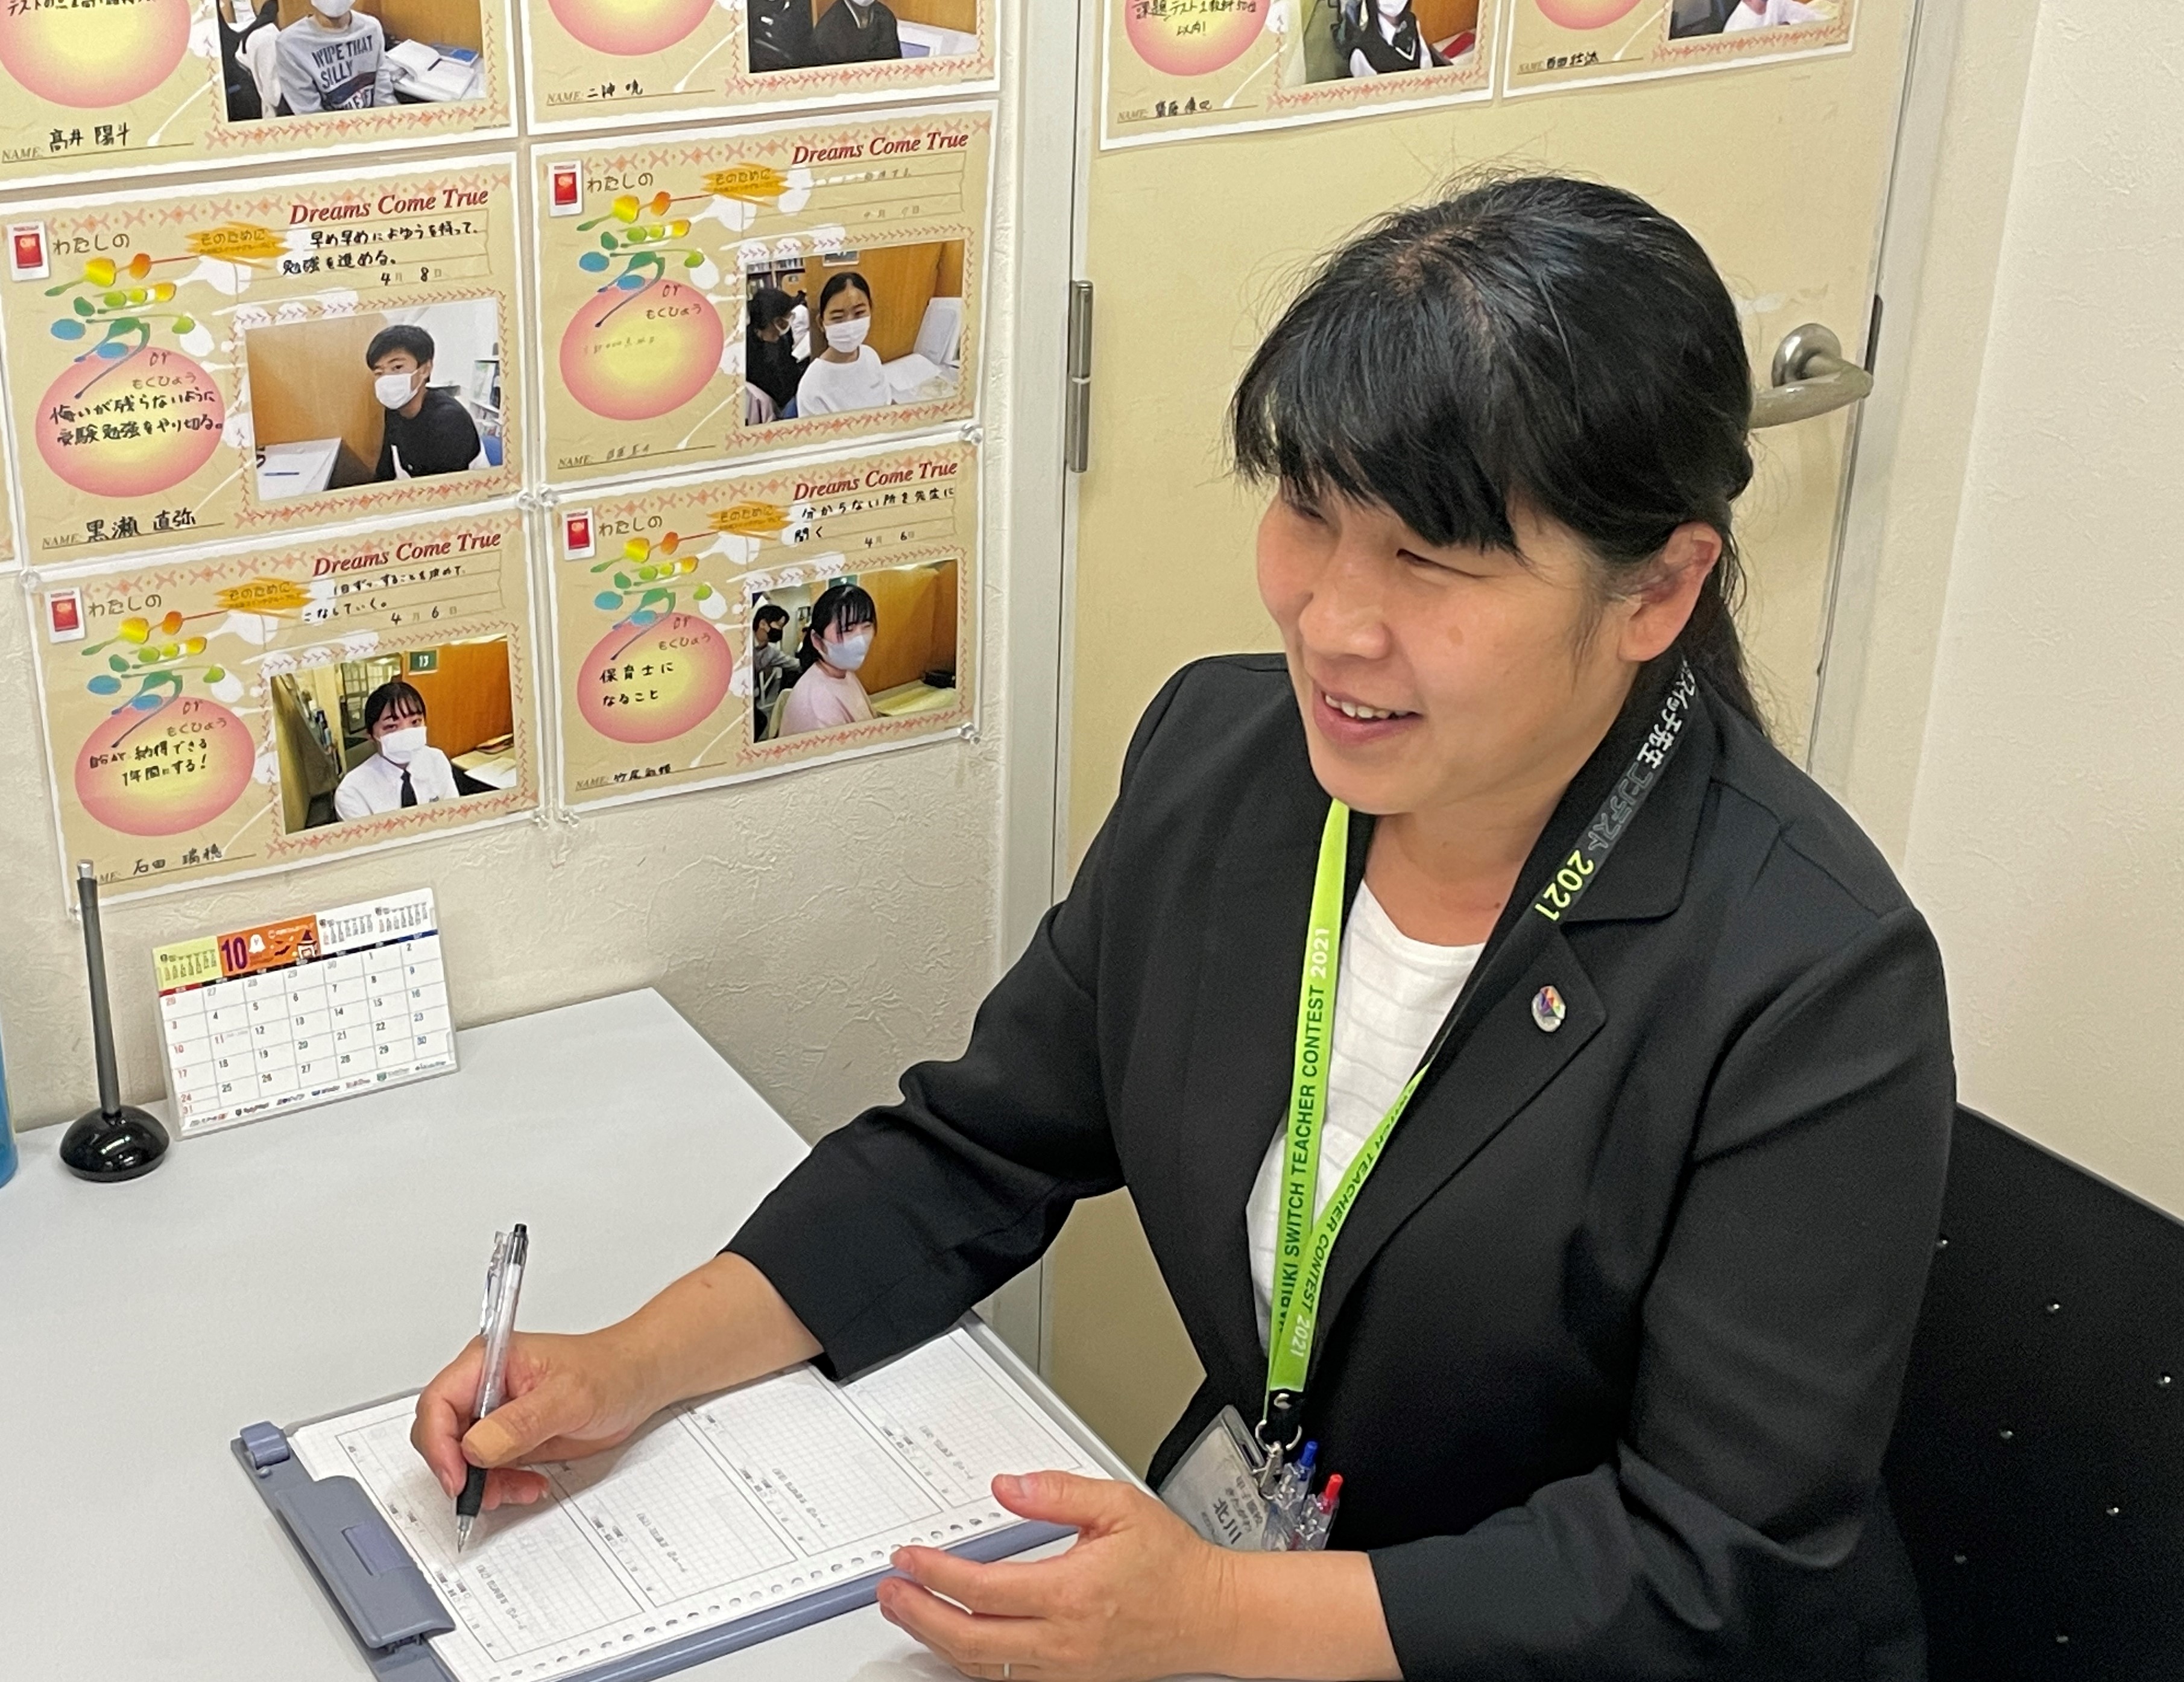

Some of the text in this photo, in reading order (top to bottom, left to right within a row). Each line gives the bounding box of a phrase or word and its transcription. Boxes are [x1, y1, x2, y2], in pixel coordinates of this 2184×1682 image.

[312, 34, 373, 68] WIPE THAT
[321, 60, 353, 89] SILLY
[791, 131, 969, 165] Dreams Come True
[587, 172, 654, 193] わたしの
[715, 167, 772, 185] そのために
[289, 187, 489, 226] Dreams Come True
[52, 233, 131, 255] わたしの
[201, 228, 267, 246] そのために
[663, 283, 683, 298] or
[150, 350, 172, 367] or
[132, 371, 197, 390] もくひょう
[792, 461, 958, 501] Dreams Come True
[86, 507, 197, 543] 黒瀬 直弥
[598, 514, 663, 537] わたしの
[721, 504, 774, 523] そのために
[312, 531, 501, 577] Dreams Come True
[89, 593, 162, 618] わたしの
[229, 581, 292, 601] そのために
[673, 616, 693, 631] or
[658, 634, 713, 651] もくひょう
[599, 662, 675, 684] 保育士に
[182, 699, 204, 715] or
[602, 689, 660, 707] なること
[166, 718, 228, 738] もくひょう
[1587, 659, 1697, 851] スイッチ先生コンテスト
[133, 858, 166, 876] 石田
[1534, 849, 1595, 922] 2021
[221, 935, 250, 972] 10
[368, 952, 373, 960] 1
[406, 943, 412, 952] 2
[1310, 928, 1330, 980] 2021
[212, 1010, 219, 1020] 4
[253, 1002, 259, 1011] 5
[293, 993, 298, 1002] 6
[332, 984, 338, 993] 7
[371, 975, 377, 984] 8
[409, 966, 415, 975] 9
[174, 988, 421, 1055] 10 11 12 13 14 15 16
[1301, 984, 1325, 1078] CONTEST
[178, 1013, 424, 1078] 17 18 19 20 21 22 23
[181, 1035, 428, 1103] 24 25 26 27 28 29 30
[181, 1105, 193, 1114] 31
[1291, 1084, 1316, 1176] TEACHER
[1326, 1152, 1375, 1233] TEACHER
[1284, 1181, 1305, 1257] SWITCH
[1301, 1233, 1329, 1314] CONTEST
[1290, 1314, 1311, 1358] 2021
[1213, 1497, 1243, 1545] 北川
